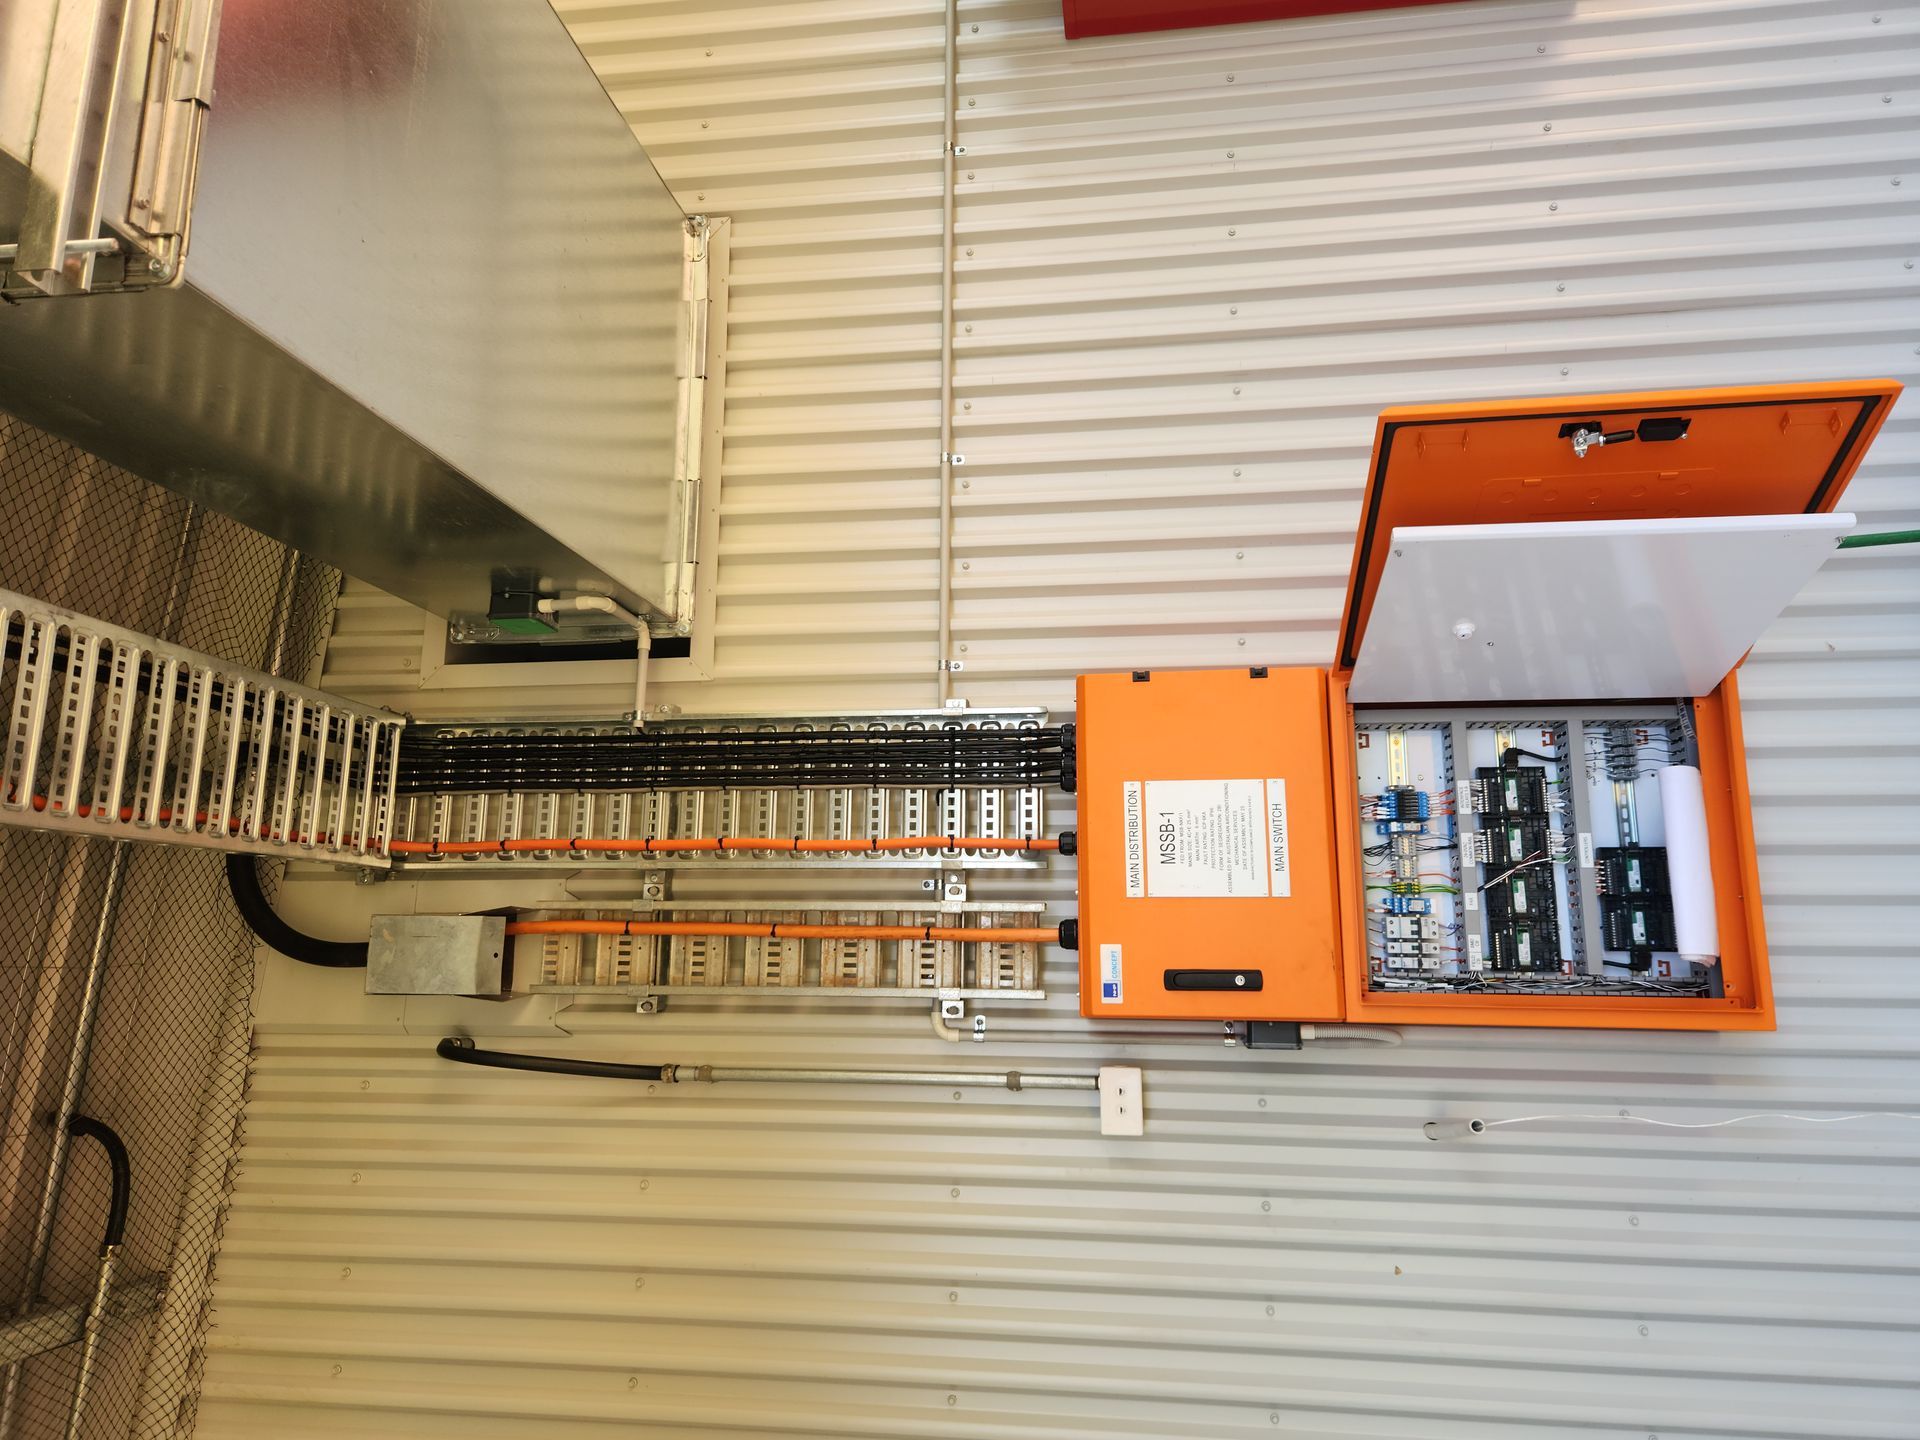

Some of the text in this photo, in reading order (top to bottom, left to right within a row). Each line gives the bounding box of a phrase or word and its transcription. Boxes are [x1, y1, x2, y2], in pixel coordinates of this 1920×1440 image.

[1128, 790, 1140, 888] MAIN DISTRIBUTION
[1159, 811, 1176, 865] MSSB-1
[1272, 803, 1285, 872] MAIN SWITCH
